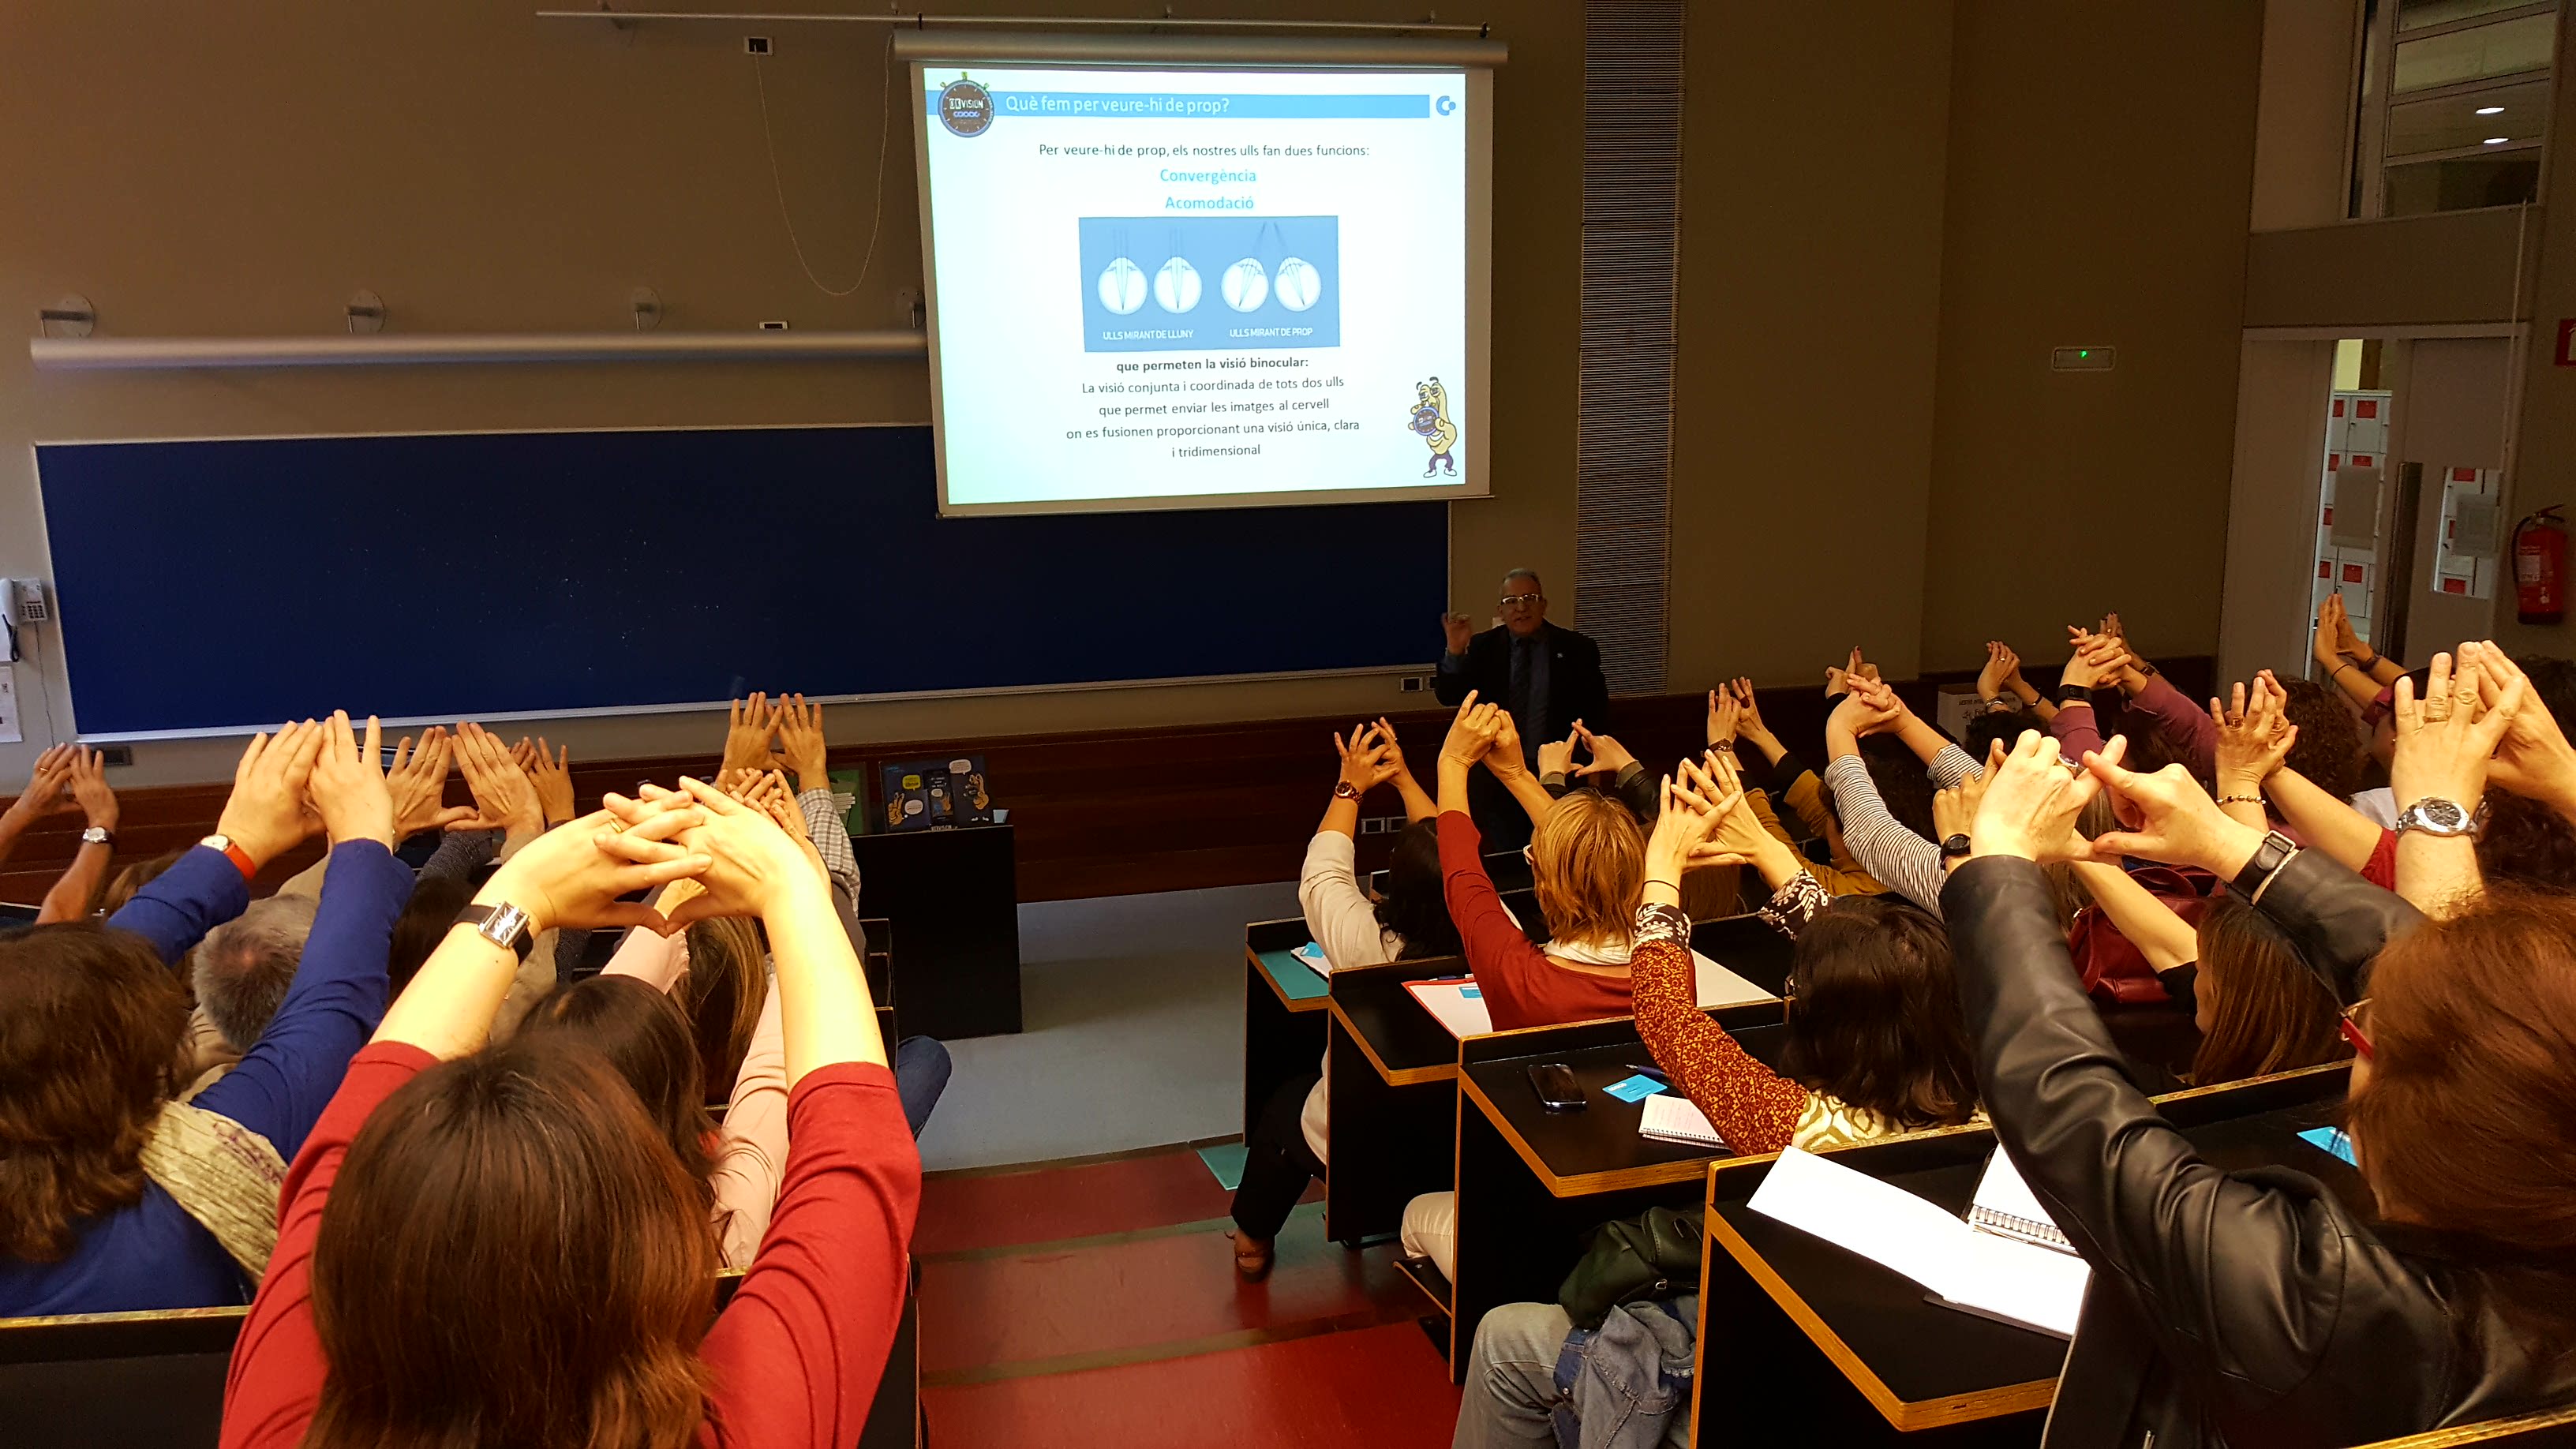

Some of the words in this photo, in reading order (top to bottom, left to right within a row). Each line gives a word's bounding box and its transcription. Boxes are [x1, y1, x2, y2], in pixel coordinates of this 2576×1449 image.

[1005, 95, 1039, 111] Què
[1041, 95, 1070, 110] fem
[1073, 100, 1099, 113] per
[1101, 97, 1163, 112] veure-hi
[1165, 98, 1184, 112] de
[1187, 98, 1230, 115] prop?
[1039, 144, 1059, 155] Per
[1063, 144, 1115, 155] veure-hi
[1118, 144, 1133, 155] de
[1137, 147, 1170, 158] prop,
[1172, 144, 1189, 155] els
[1193, 146, 1237, 156] nostres
[1240, 144, 1260, 156] ulls
[1263, 144, 1281, 156] fan
[1284, 144, 1312, 156] dues
[1316, 144, 1369, 155] funcions:
[1159, 168, 1257, 185] Convergència
[1165, 195, 1254, 209] Acomodació
[1103, 331, 1123, 340] ULLS
[1123, 331, 1155, 339] MIRANT
[1155, 330, 1168, 339] DE
[1167, 329, 1194, 339] LLUNY
[1229, 328, 1249, 338] ULLS
[1249, 328, 1279, 338] MIRANT
[1280, 328, 1292, 337] DE
[1291, 327, 1313, 336] PROP
[1116, 363, 1140, 374] que
[1143, 361, 1202, 373] permeten
[1205, 358, 1216, 369] la
[1219, 358, 1246, 369] visió
[1250, 356, 1309, 368] binocular:
[1082, 383, 1095, 394] La
[1098, 382, 1125, 393] visió
[1128, 382, 1180, 395] conjunta
[1189, 379, 1255, 391] coordinada
[1258, 378, 1273, 390] de
[1275, 380, 1297, 389] tots
[1301, 377, 1323, 388] dos
[1325, 376, 1344, 387] ulls
[1099, 407, 1121, 417] que
[1125, 405, 1167, 417] permet
[1171, 402, 1208, 414] enviar
[1211, 402, 1227, 413] les
[1230, 401, 1275, 414] imatges
[1279, 399, 1288, 411] al
[1292, 398, 1329, 410] cervell
[1066, 430, 1082, 440] on
[1085, 429, 1099, 439] es
[1102, 426, 1153, 438] fusionen
[1156, 424, 1240, 439] proporcionant
[1243, 425, 1264, 433] una
[1267, 421, 1294, 432] visió
[1297, 421, 1331, 432] única,
[1334, 419, 1360, 430] clara
[1178, 444, 1260, 458] tridimensional
